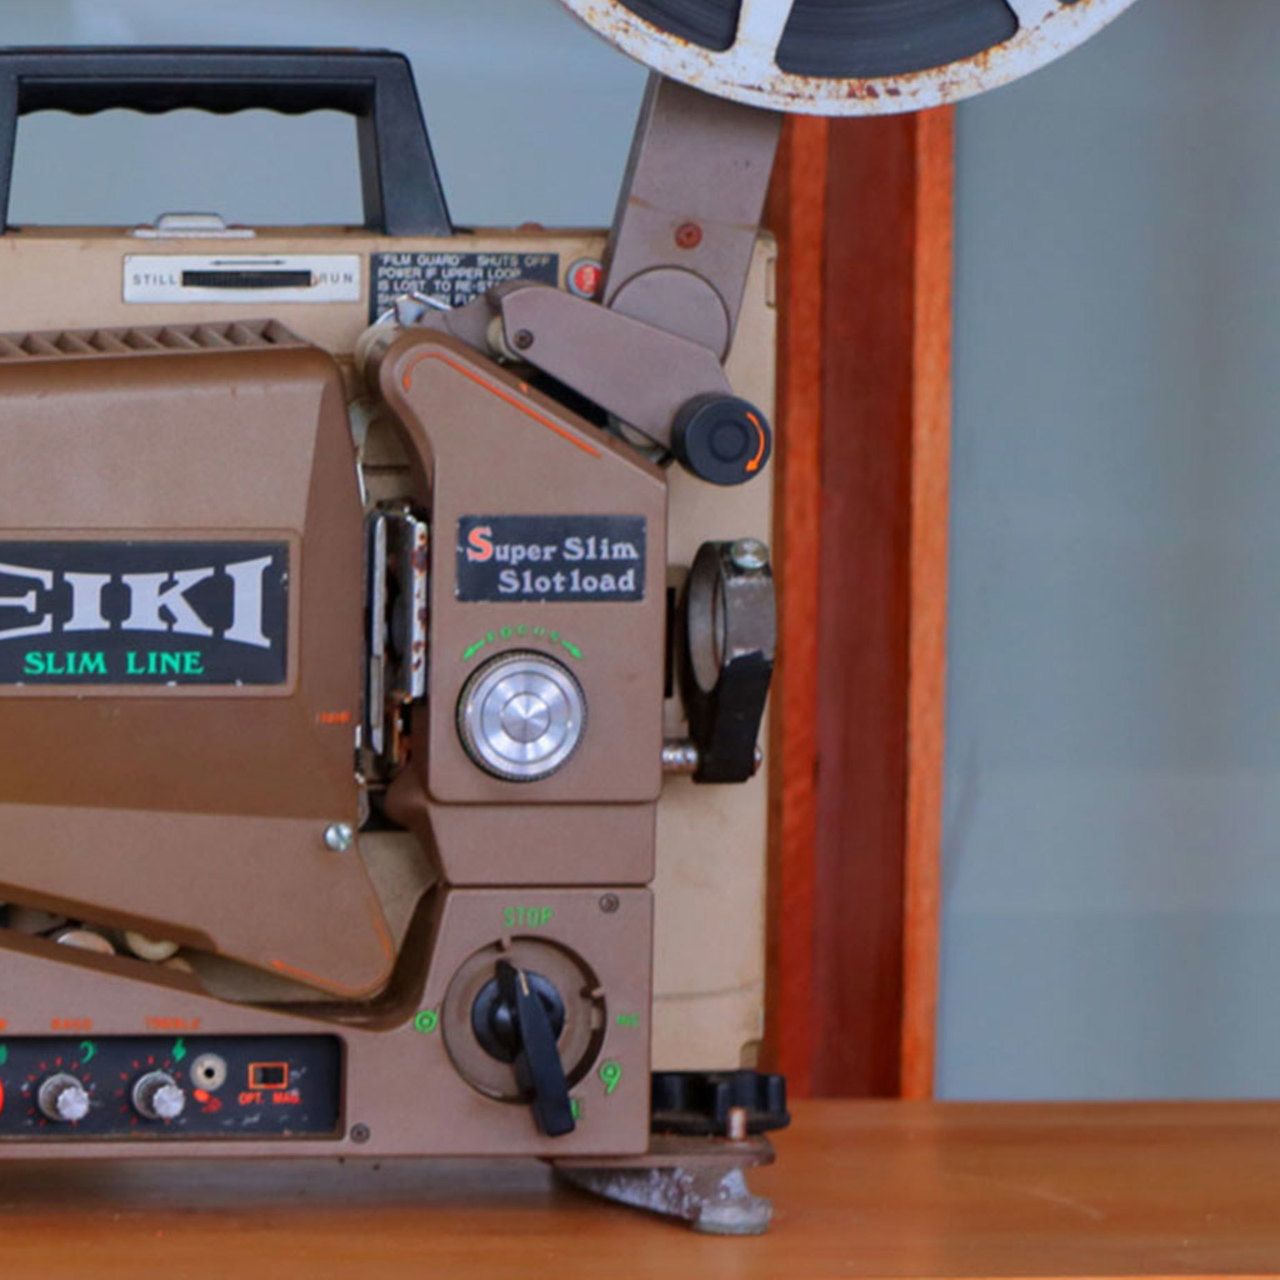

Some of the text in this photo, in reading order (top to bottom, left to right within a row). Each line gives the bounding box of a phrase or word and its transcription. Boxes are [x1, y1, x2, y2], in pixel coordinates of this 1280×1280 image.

[524, 256, 551, 268] OFF
[132, 273, 354, 286] STILL RUN
[377, 267, 422, 279] POWER
[441, 267, 483, 279] UPPER
[487, 268, 521, 279] LOOP
[434, 280, 452, 292] TO
[466, 526, 640, 565] Super Slim
[23, 650, 205, 675] SLIM LINE
[502, 906, 555, 928] STOP
